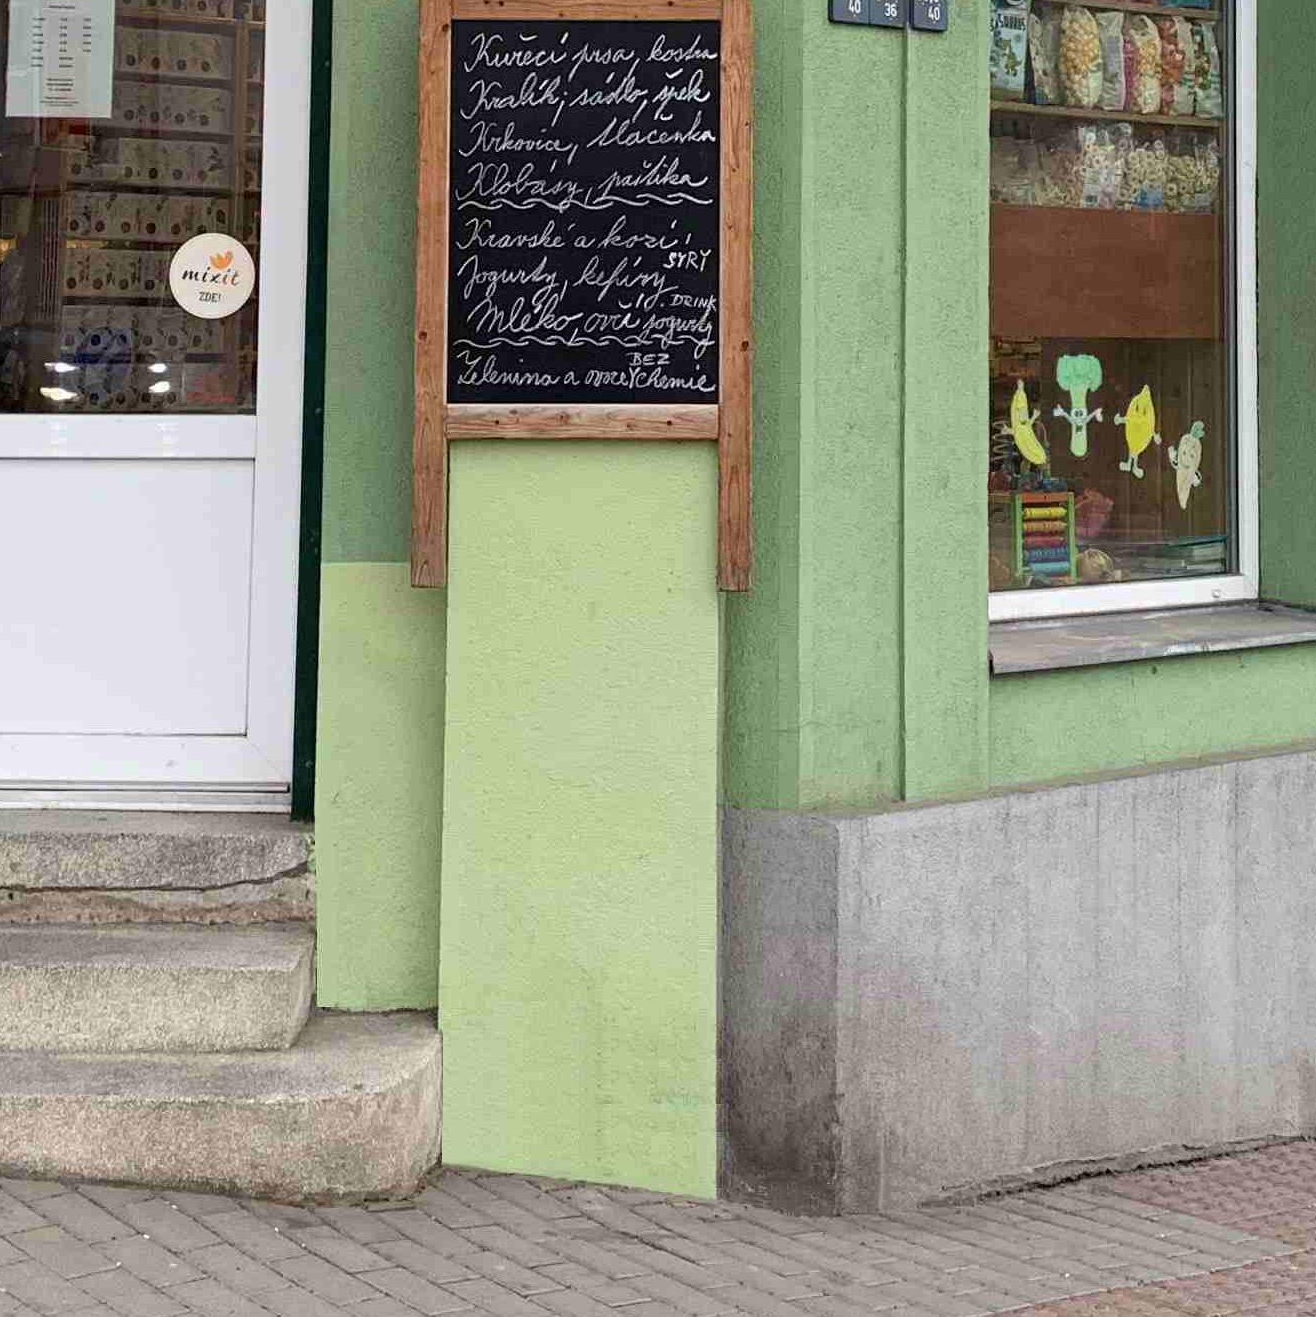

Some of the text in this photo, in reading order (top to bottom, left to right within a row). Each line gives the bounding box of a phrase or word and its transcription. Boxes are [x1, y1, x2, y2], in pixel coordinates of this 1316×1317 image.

[849, 0, 861, 13] 40
[928, 6, 940, 21] 40
[575, 234, 592, 249] a
[182, 267, 239, 287] mixit
[628, 352, 671, 367] BEZ
